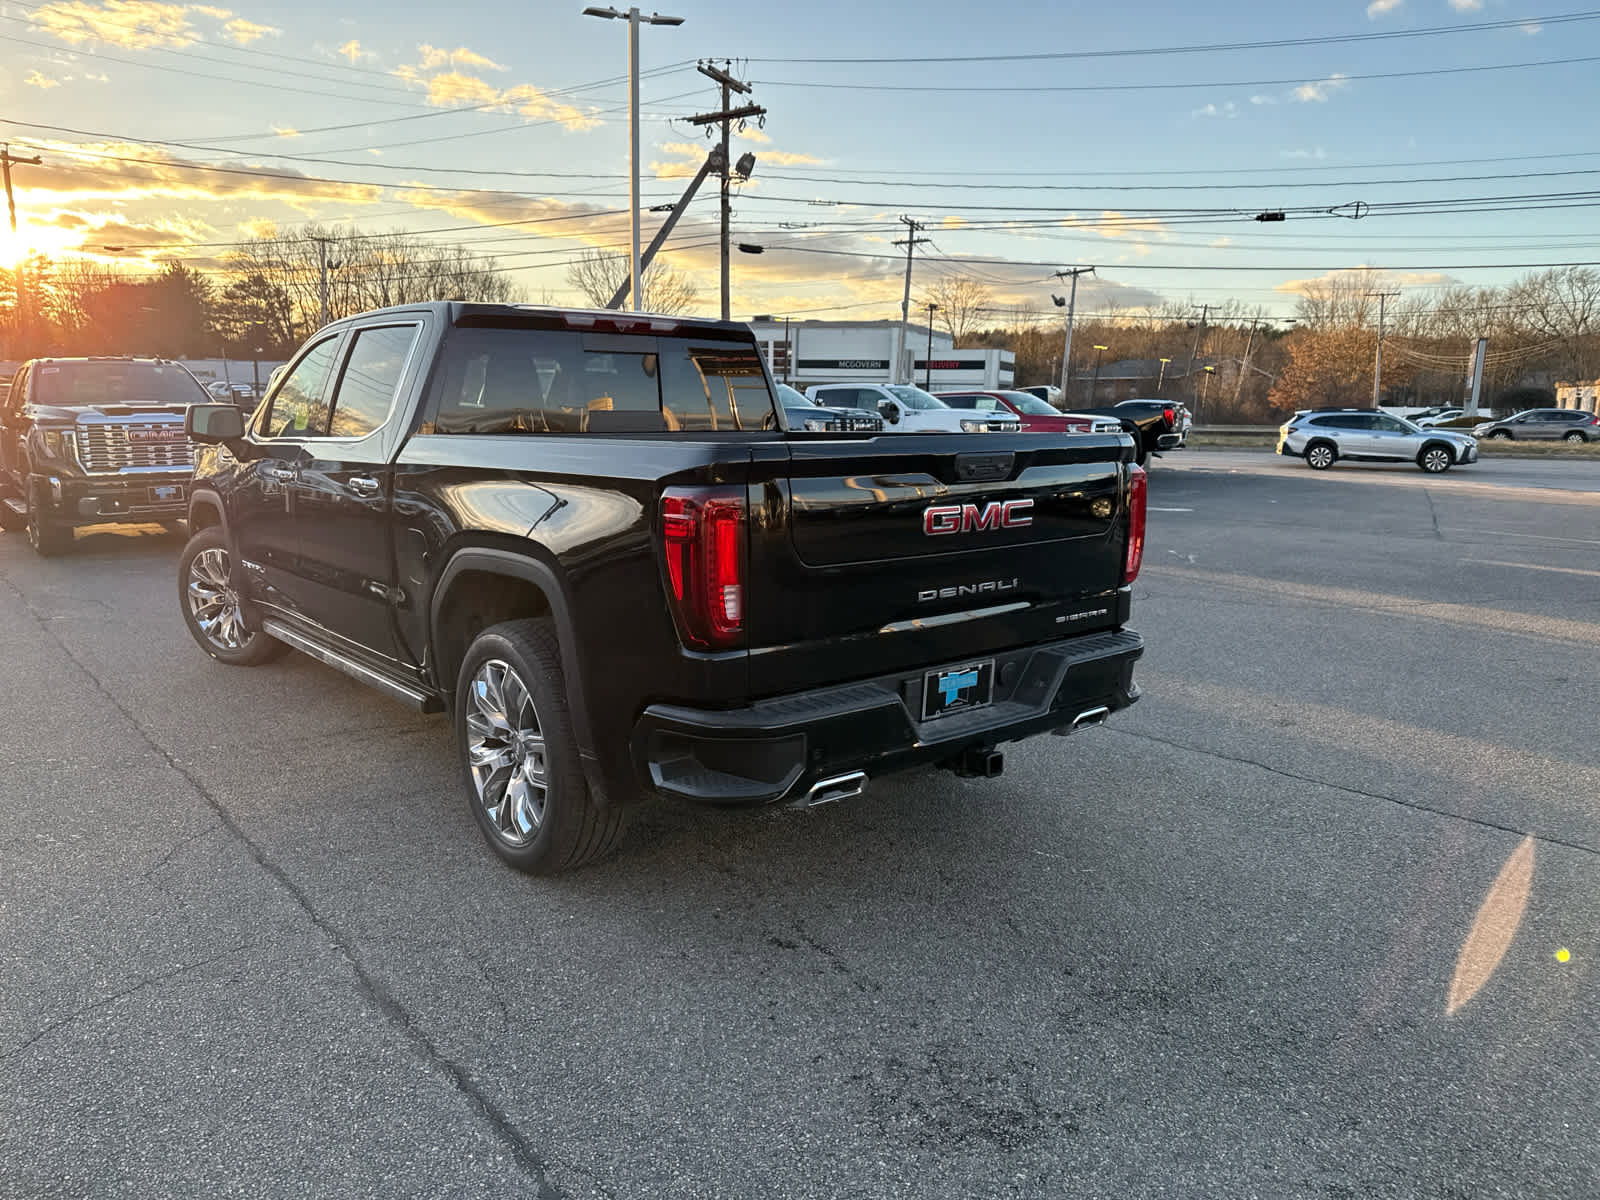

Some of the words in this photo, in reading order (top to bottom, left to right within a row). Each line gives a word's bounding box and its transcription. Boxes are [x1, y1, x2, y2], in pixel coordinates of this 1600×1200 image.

[923, 498, 1034, 536] GMC
[917, 577, 1019, 602] DENALI
[1055, 608, 1108, 624] SIERRA
